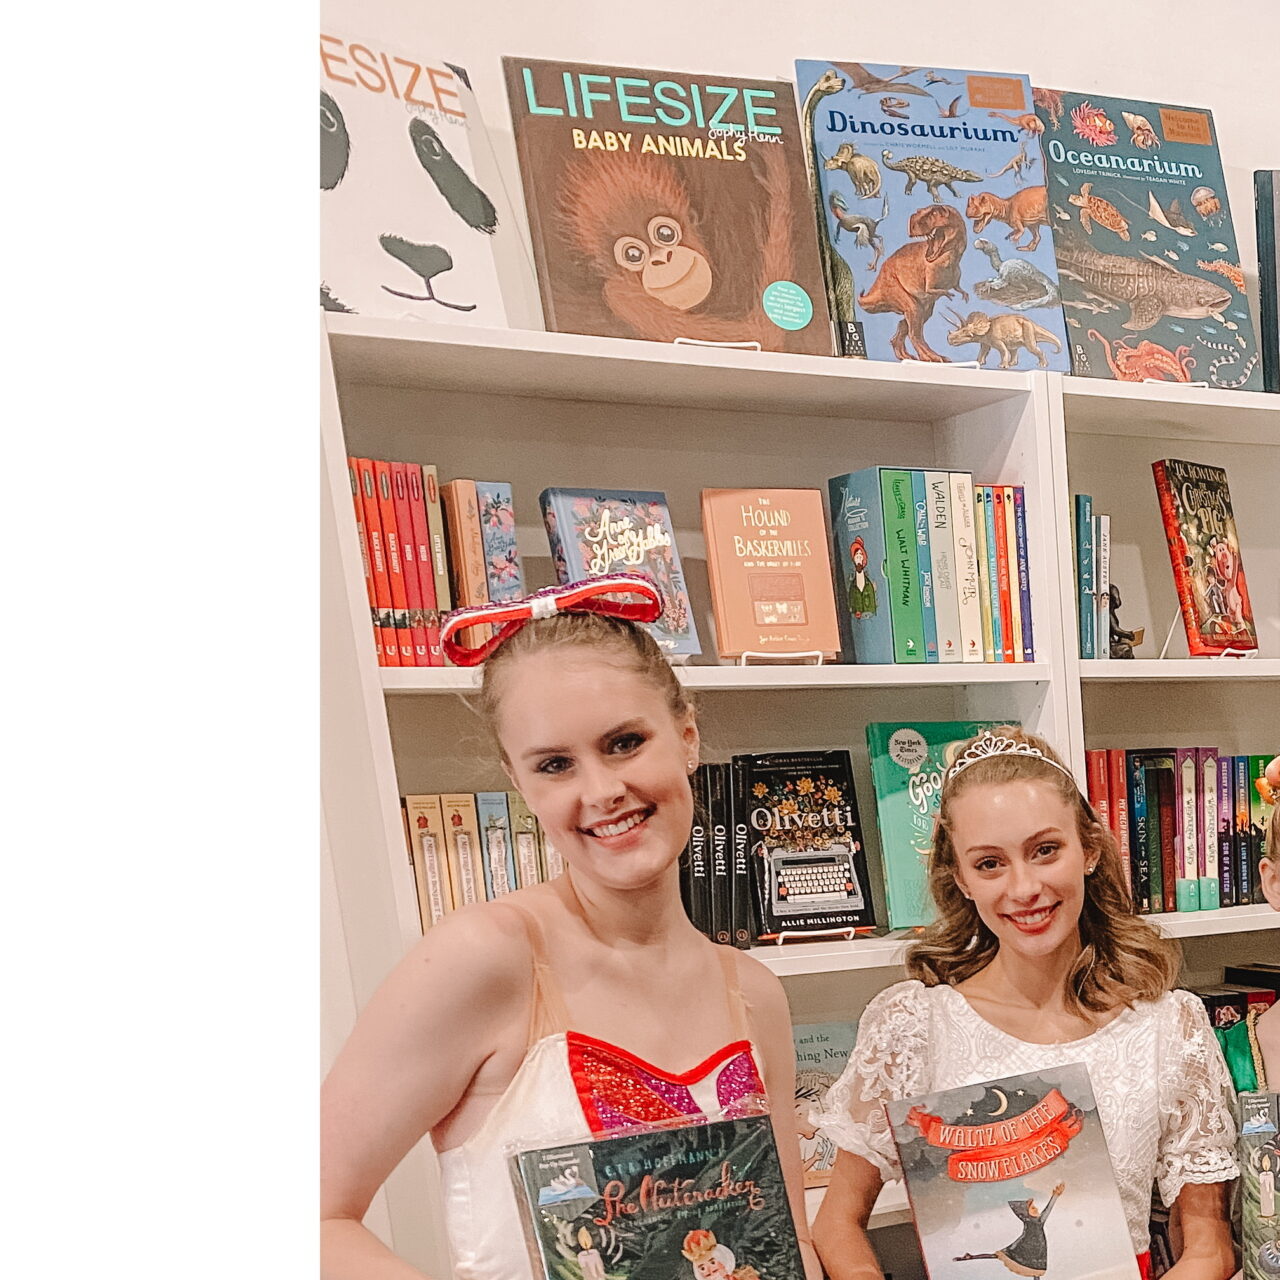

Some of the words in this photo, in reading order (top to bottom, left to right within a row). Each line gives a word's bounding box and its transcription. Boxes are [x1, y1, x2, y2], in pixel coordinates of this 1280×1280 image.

[522, 67, 783, 135] LIFESIZE
[826, 110, 1019, 143] Dinosaurium
[571, 128, 632, 153] BABY
[640, 134, 748, 162] ANIMALS
[1048, 140, 1204, 178] Oceanarium
[931, 480, 948, 529] WALDEN
[1198, 506, 1225, 535] PIG
[584, 508, 635, 545] Anne
[895, 528, 908, 555] WALT
[958, 537, 975, 570] JOHN
[900, 559, 912, 607] WHITMAN
[1101, 554, 1109, 587] AUSTEN
[963, 571, 977, 606] MUIR
[899, 745, 918, 753] Times
[907, 739, 922, 748] York
[750, 805, 857, 831] Olivetti
[1118, 798, 1126, 810] MY
[1137, 816, 1147, 843] SKIN
[691, 825, 706, 878] Olivetti
[714, 824, 727, 877] Olivetti
[735, 823, 748, 875] Olivetti
[1139, 860, 1149, 883] SEA
[1223, 872, 1231, 893] WITCH
[781, 918, 805, 927] ALLIE
[807, 915, 860, 926] MILLINGTON
[799, 1034, 814, 1045] and
[816, 1034, 830, 1043] the
[823, 1048, 849, 1060] New
[938, 1125, 997, 1147] WALTZ
[1000, 1122, 1018, 1142] OF
[1021, 1101, 1056, 1133] THE
[957, 1136, 1062, 1180] SNOWFLAKES
[593, 1180, 640, 1227] The
[639, 1160, 766, 1211] Nutcracker
